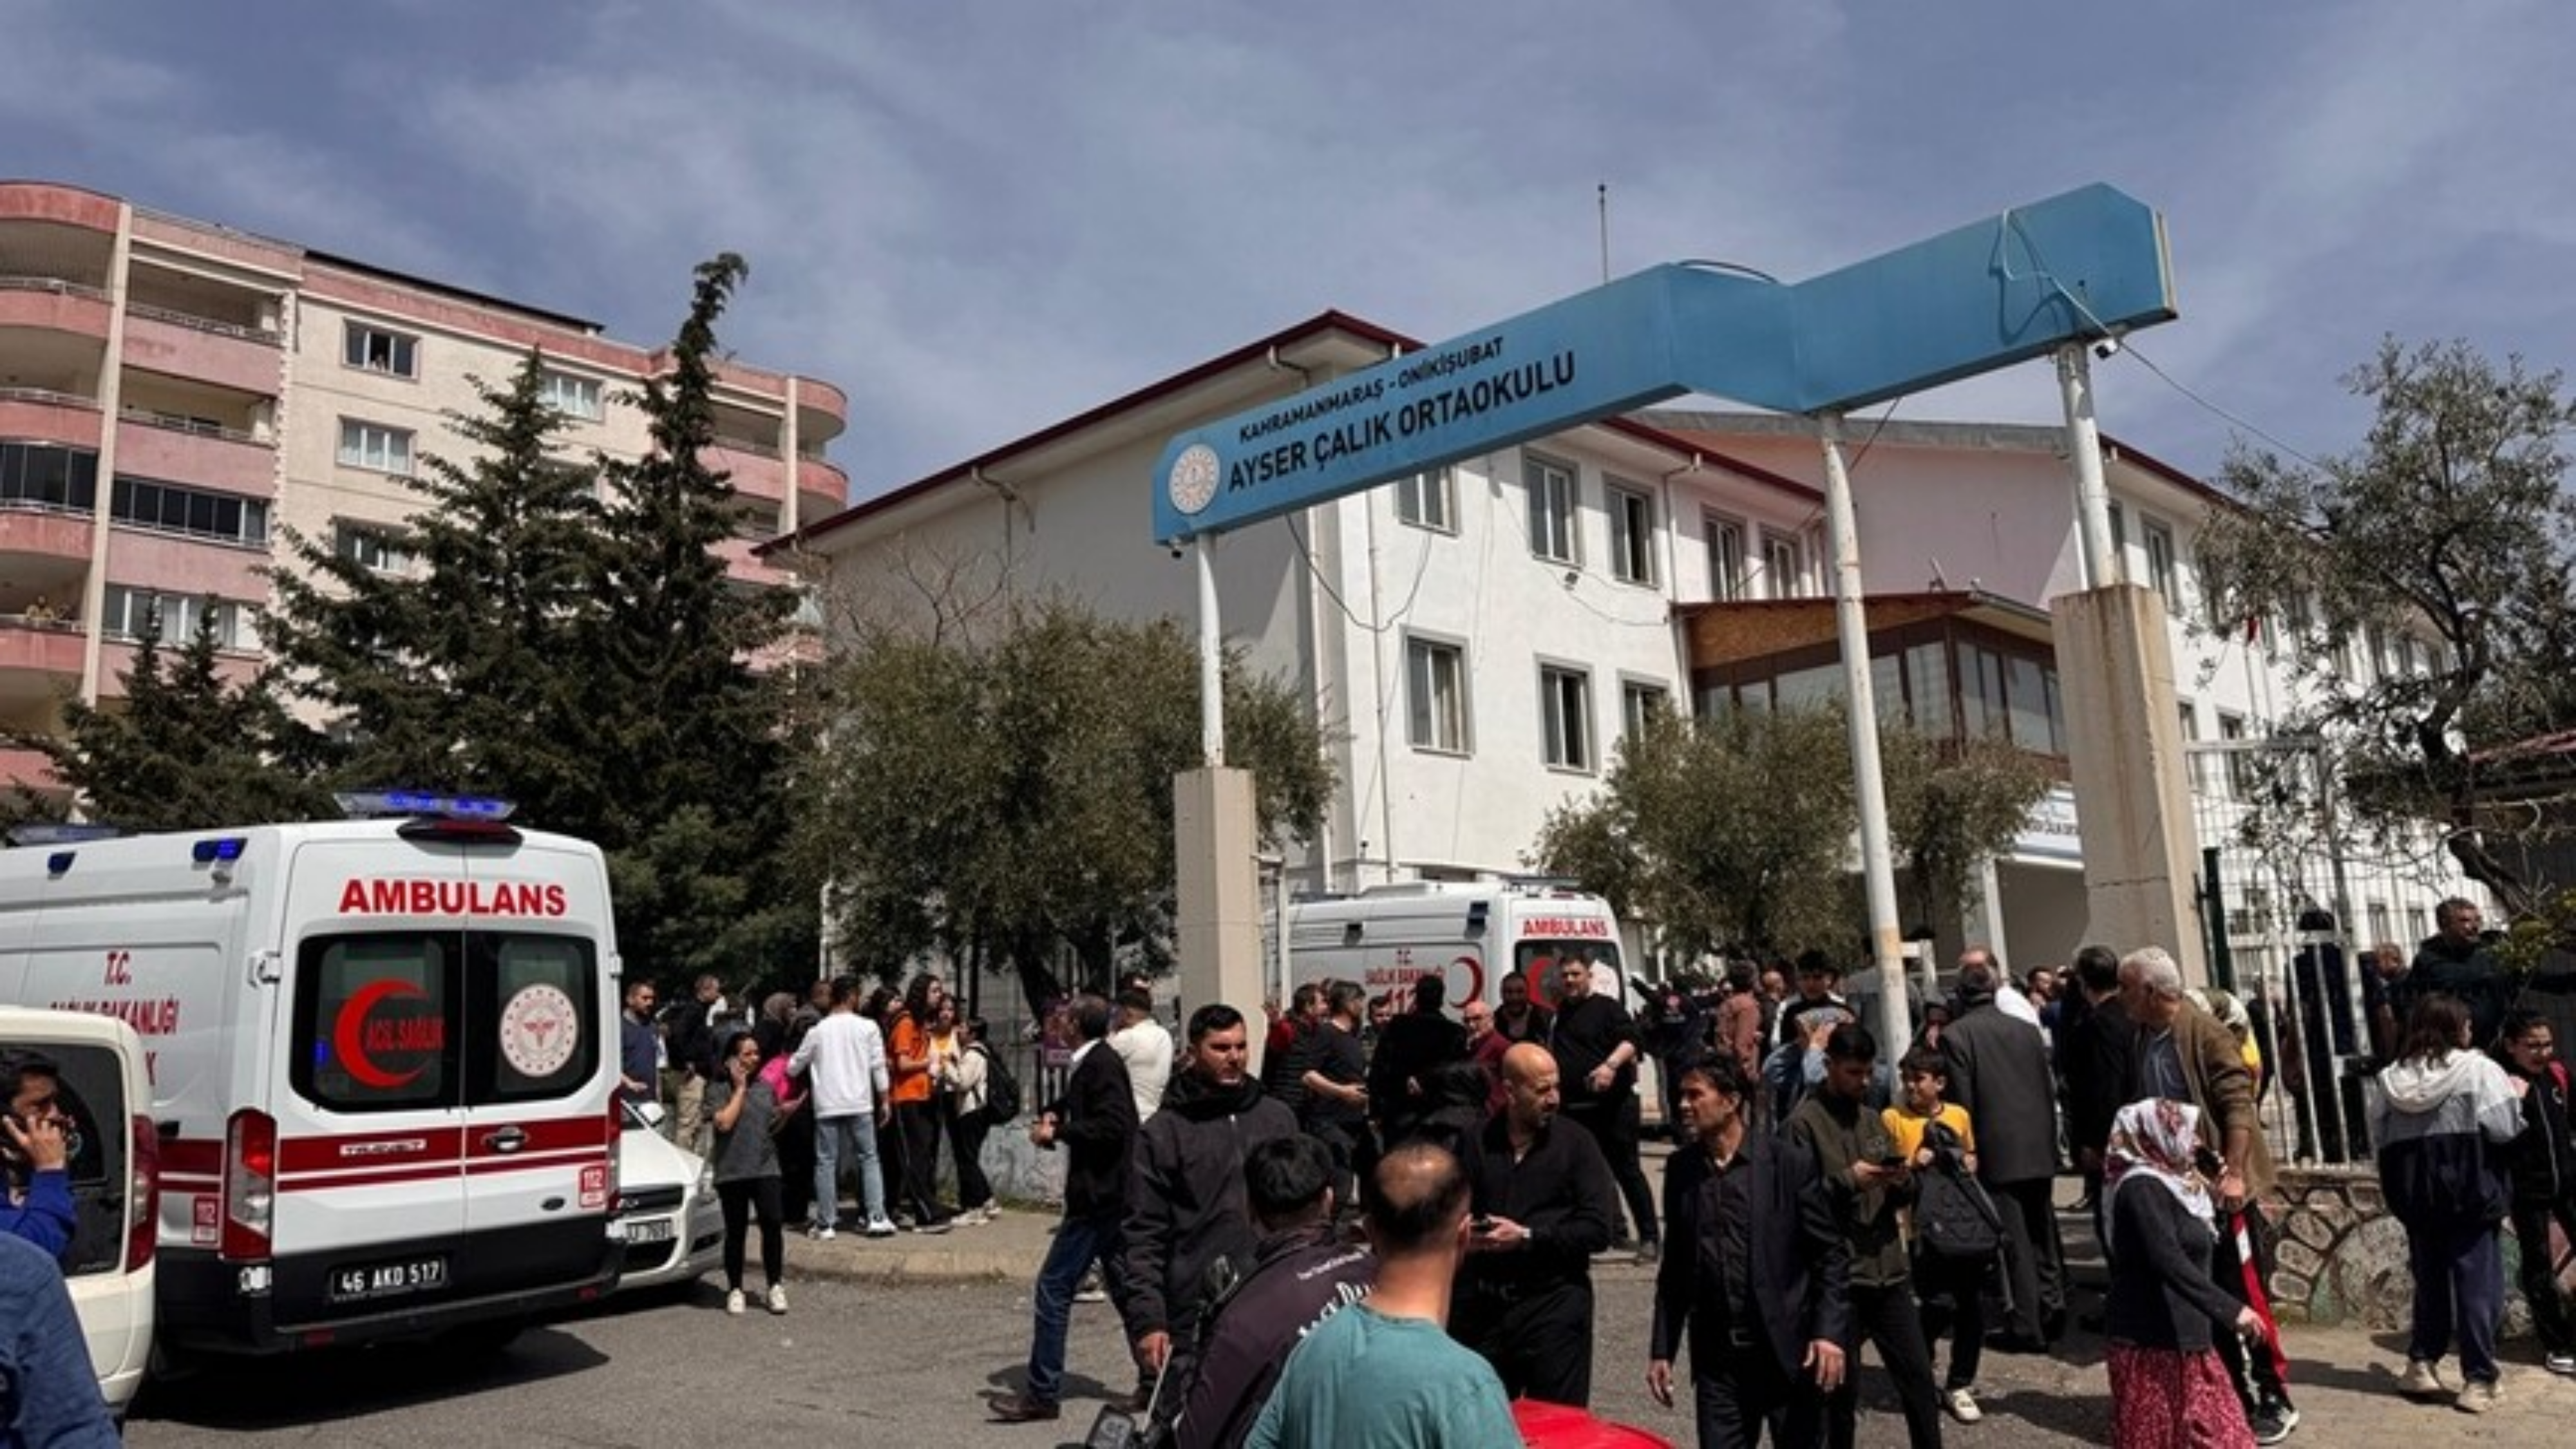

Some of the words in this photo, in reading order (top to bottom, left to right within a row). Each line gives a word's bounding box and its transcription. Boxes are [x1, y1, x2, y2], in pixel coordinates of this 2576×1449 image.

[1239, 377, 1385, 444] KAHRAMANMARAŞ
[1397, 336, 1504, 388] ONİKİŞUBAT
[1228, 440, 1307, 493] AYSER
[1314, 411, 1392, 471] ÇALIK
[1397, 350, 1575, 437] ORTAOKULU
[339, 878, 566, 916] AMBULANS
[1523, 916, 1608, 937] AMBULANS
[342, 1269, 365, 1293] 46
[409, 1260, 440, 1284] 517
